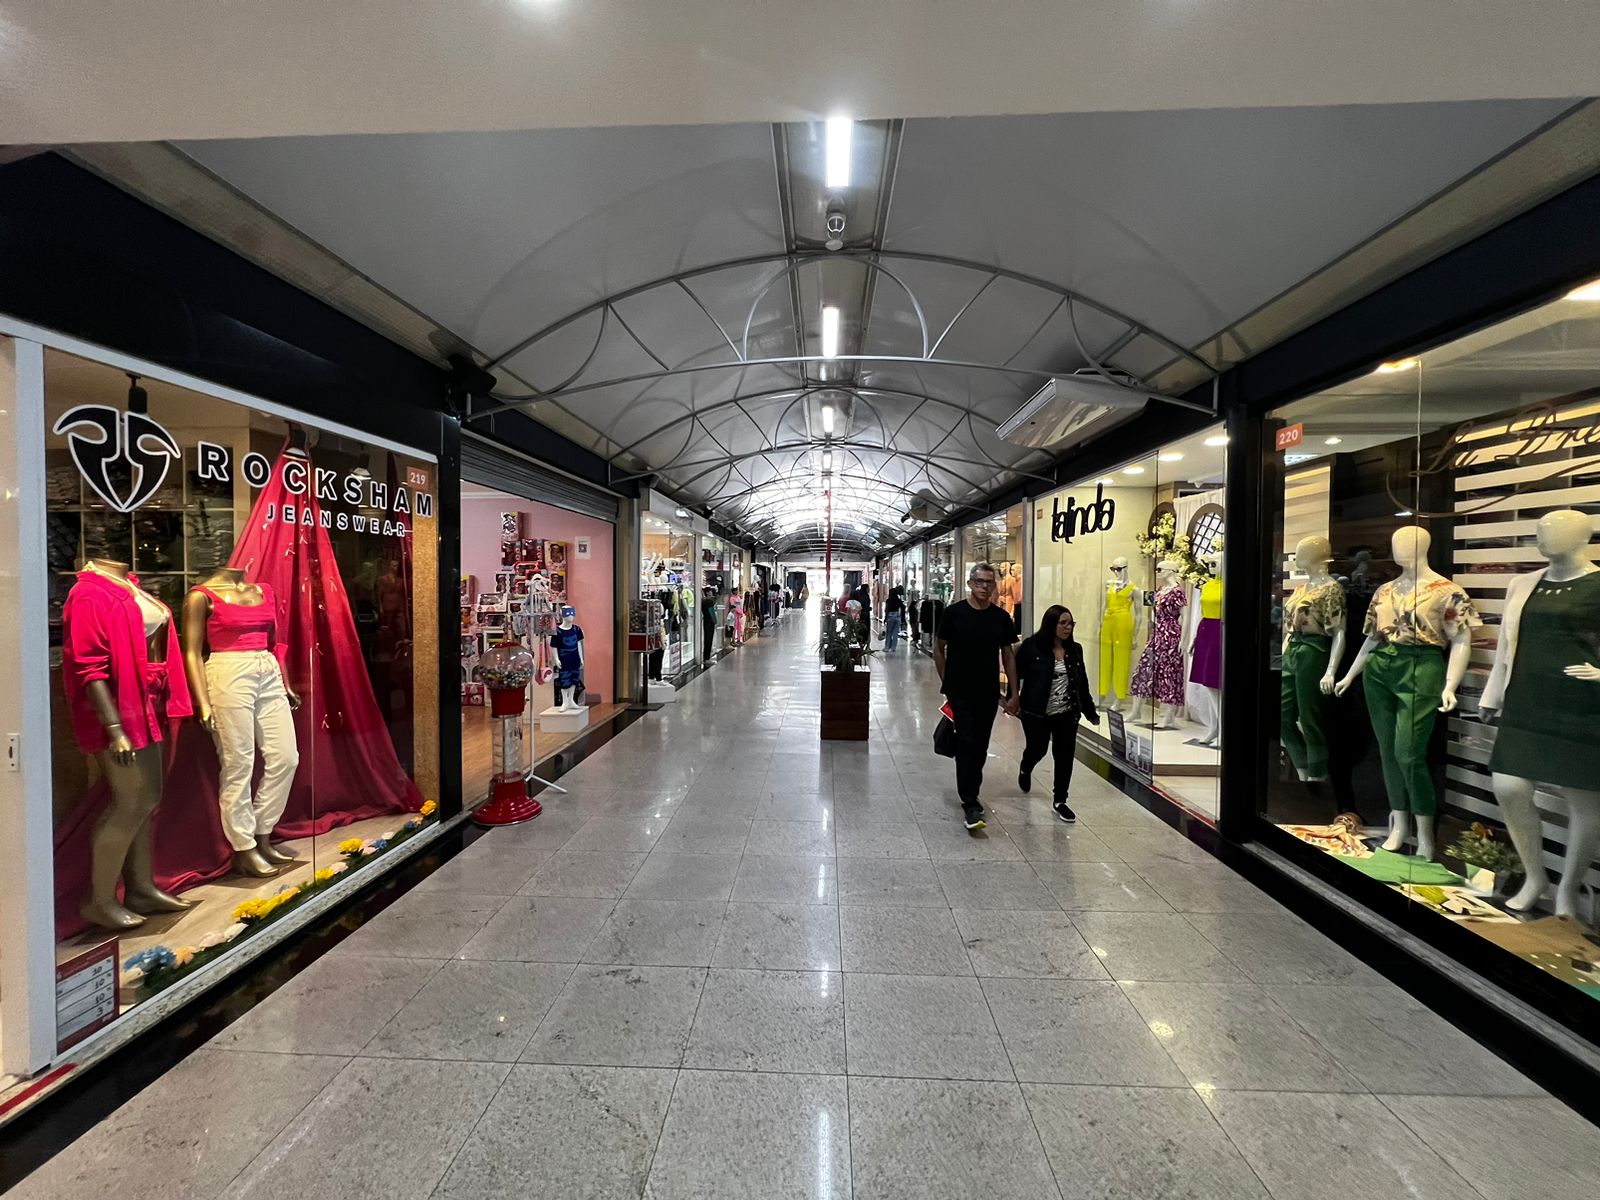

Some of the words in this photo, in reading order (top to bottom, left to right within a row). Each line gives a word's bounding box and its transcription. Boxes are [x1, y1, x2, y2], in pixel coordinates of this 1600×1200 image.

[1278, 429, 1298, 445] 220
[198, 440, 433, 518] ROCKSHAM
[410, 472, 426, 485] 219
[267, 504, 406, 537] JEANSWEAR
